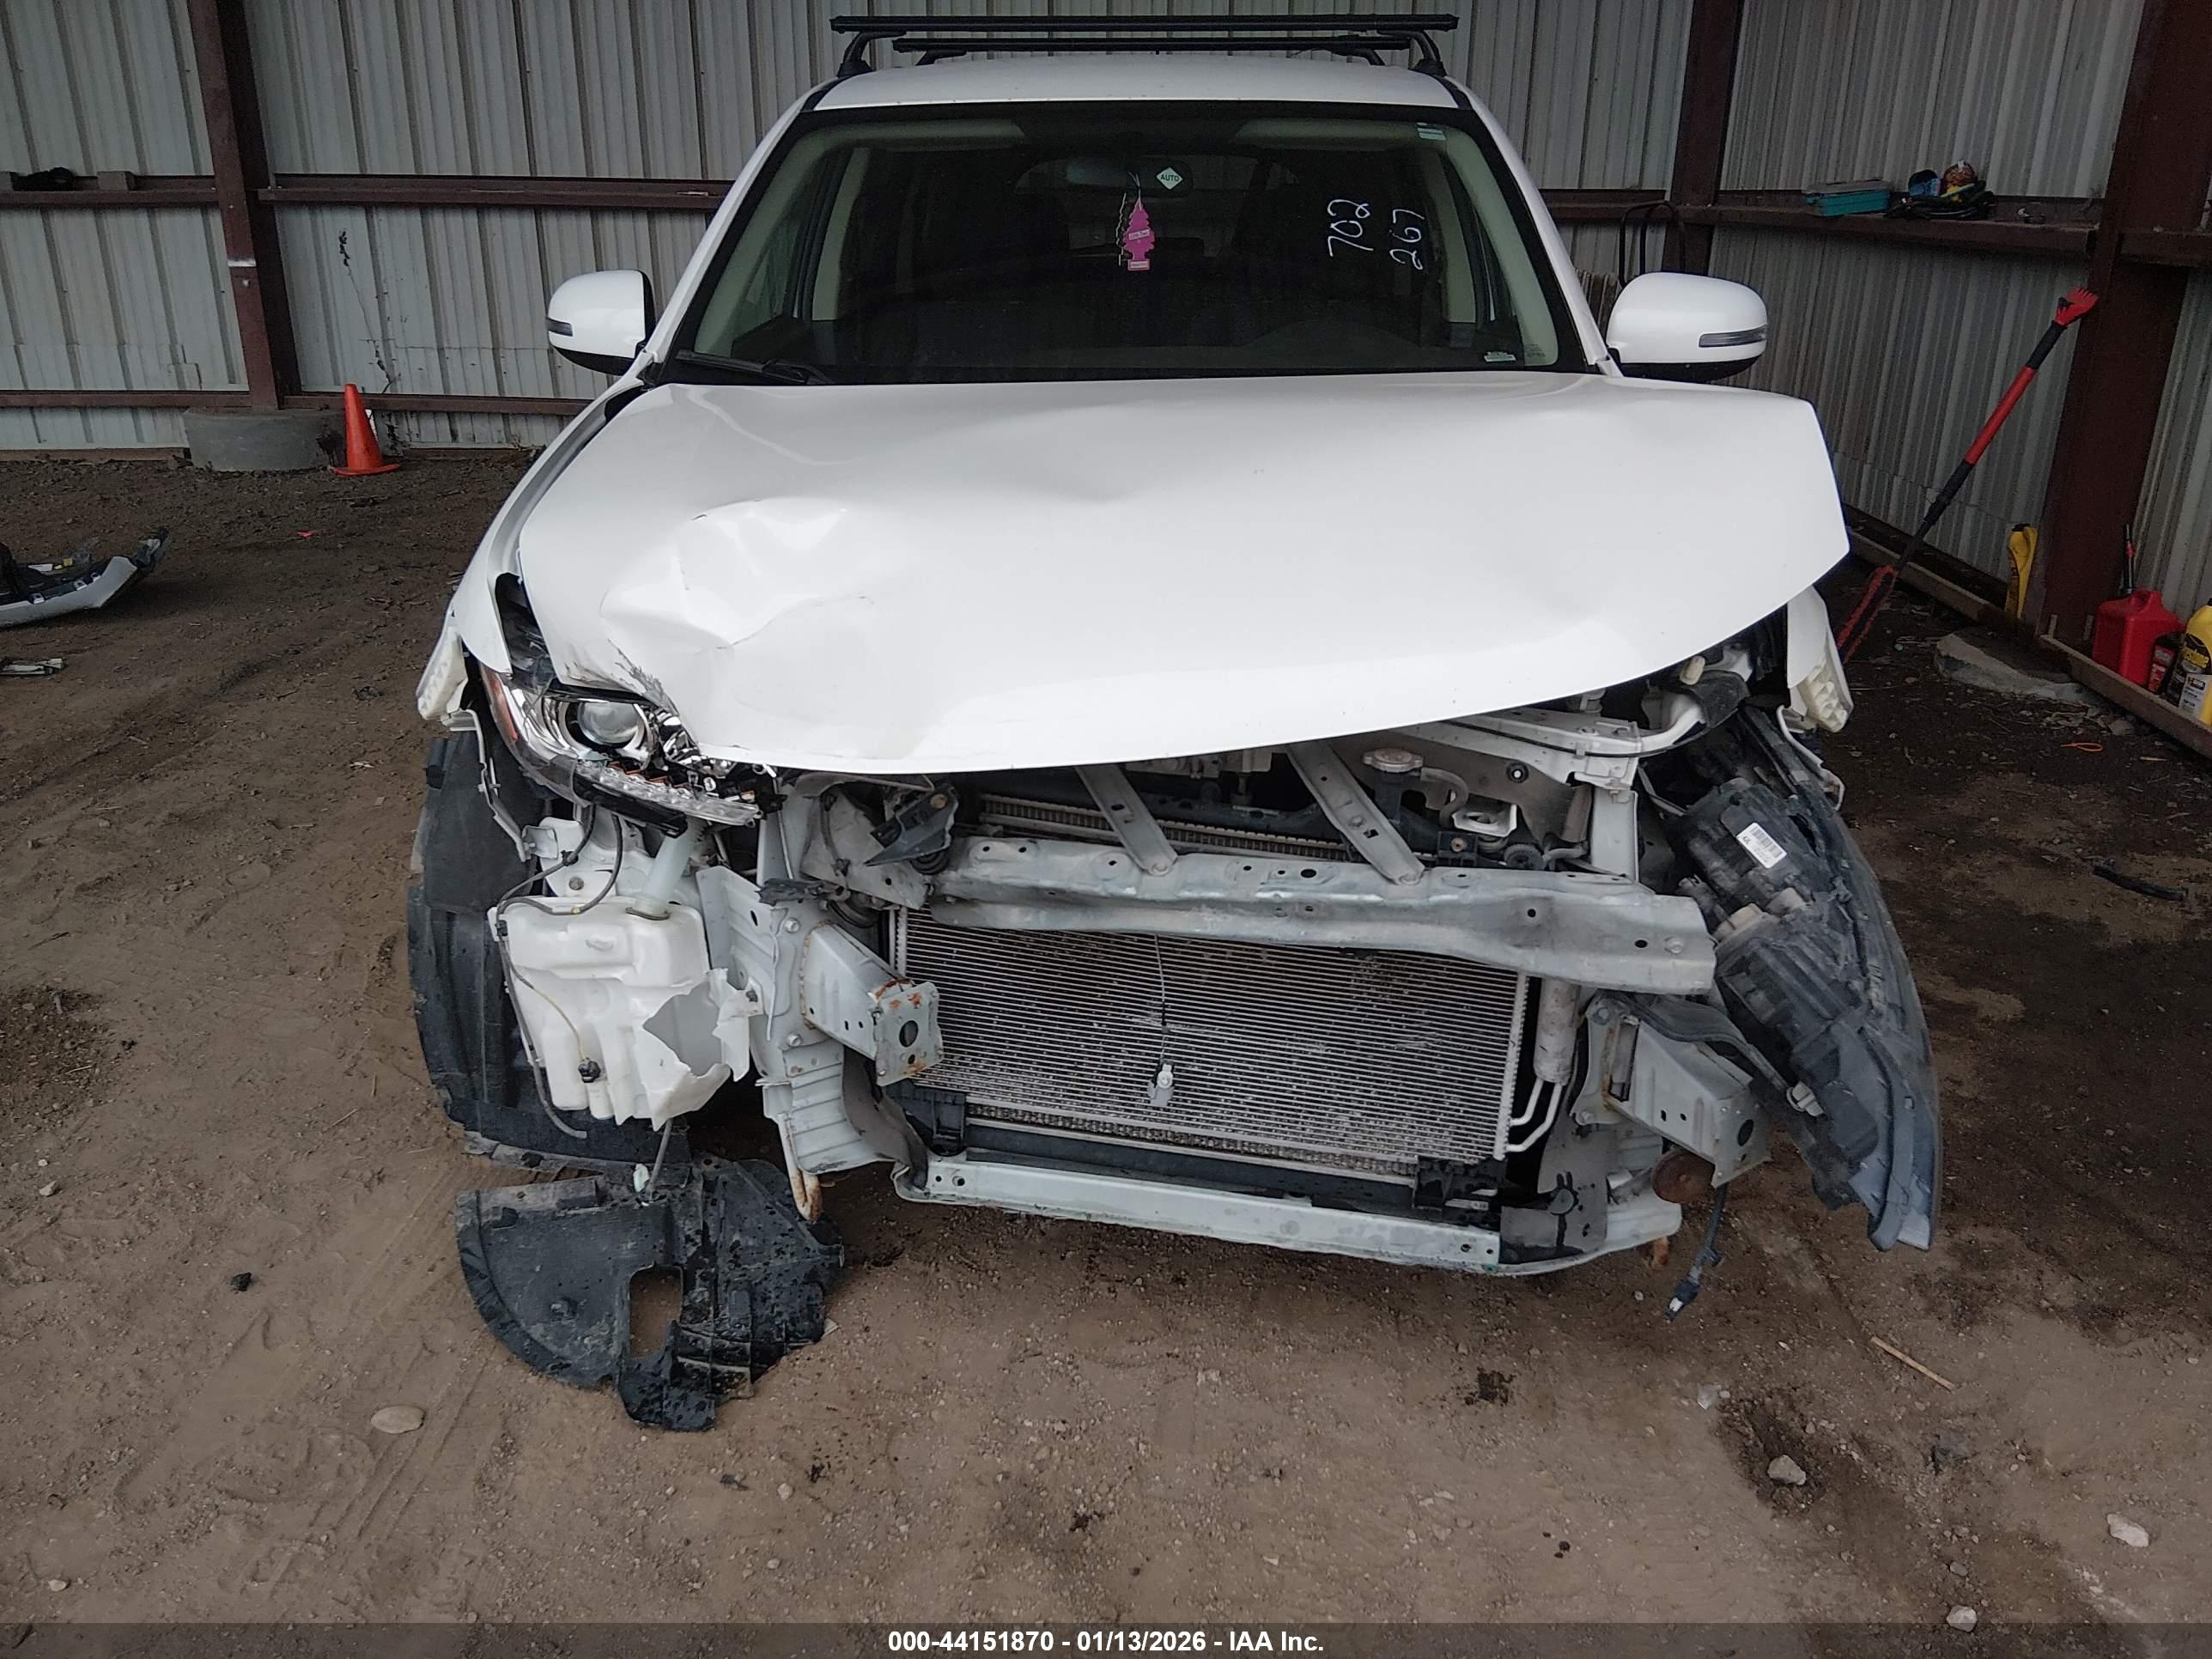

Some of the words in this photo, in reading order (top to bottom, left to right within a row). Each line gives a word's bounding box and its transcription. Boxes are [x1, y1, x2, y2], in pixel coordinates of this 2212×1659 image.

[1160, 173, 1180, 182] AUTO
[1327, 198, 1374, 258] 702
[1388, 208, 1426, 271] 267
